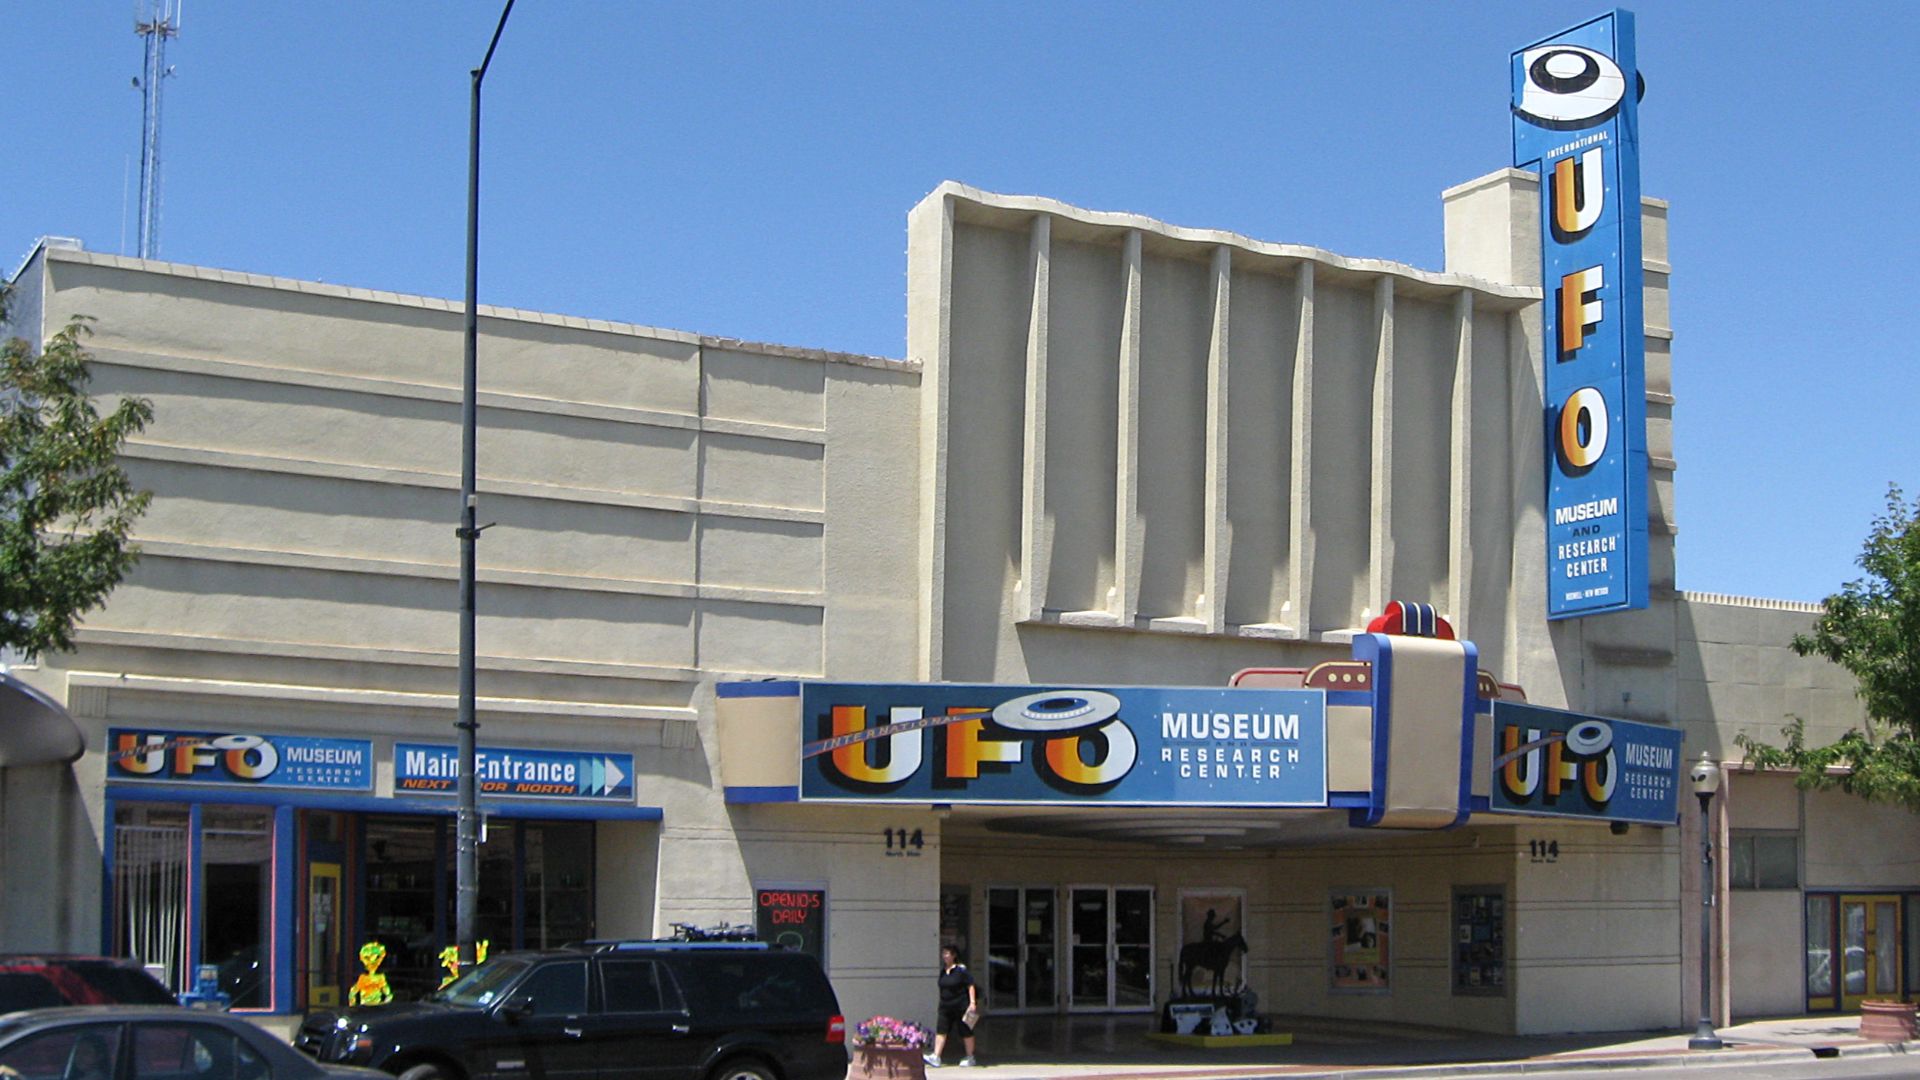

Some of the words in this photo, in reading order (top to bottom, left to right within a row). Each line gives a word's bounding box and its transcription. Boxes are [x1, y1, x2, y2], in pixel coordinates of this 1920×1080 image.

[1547, 131, 1608, 159] INTERNATIONAL
[1555, 498, 1618, 525] MUSEUM
[1573, 524, 1601, 538] AND
[1558, 536, 1616, 560] RESEARCH
[1566, 557, 1608, 578] CENTER
[823, 715, 961, 751] INTERNATIONAL
[1162, 713, 1299, 740] MUSEUM
[832, 705, 1137, 785] UFO
[118, 734, 278, 780] UFO
[286, 747, 362, 766] MUSEUM
[1161, 748, 1299, 763] RESEARCH
[1504, 724, 1617, 803] UFO
[1625, 742, 1673, 769] MUSEUM
[286, 766, 362, 777] RESEARCH
[405, 750, 459, 778] Main
[475, 753, 576, 783] Entrance
[1180, 764, 1280, 779] CENTER
[297, 774, 351, 784] CENTER
[402, 779, 451, 790] NEXT
[515, 783, 577, 795] NORTH
[1625, 772, 1672, 789] RESEARCH
[1630, 786, 1665, 801] CENTER
[884, 828, 925, 849] 114
[1529, 840, 1560, 858] 114
[760, 892, 796, 908] OPEN
[771, 908, 807, 925] DAILY
